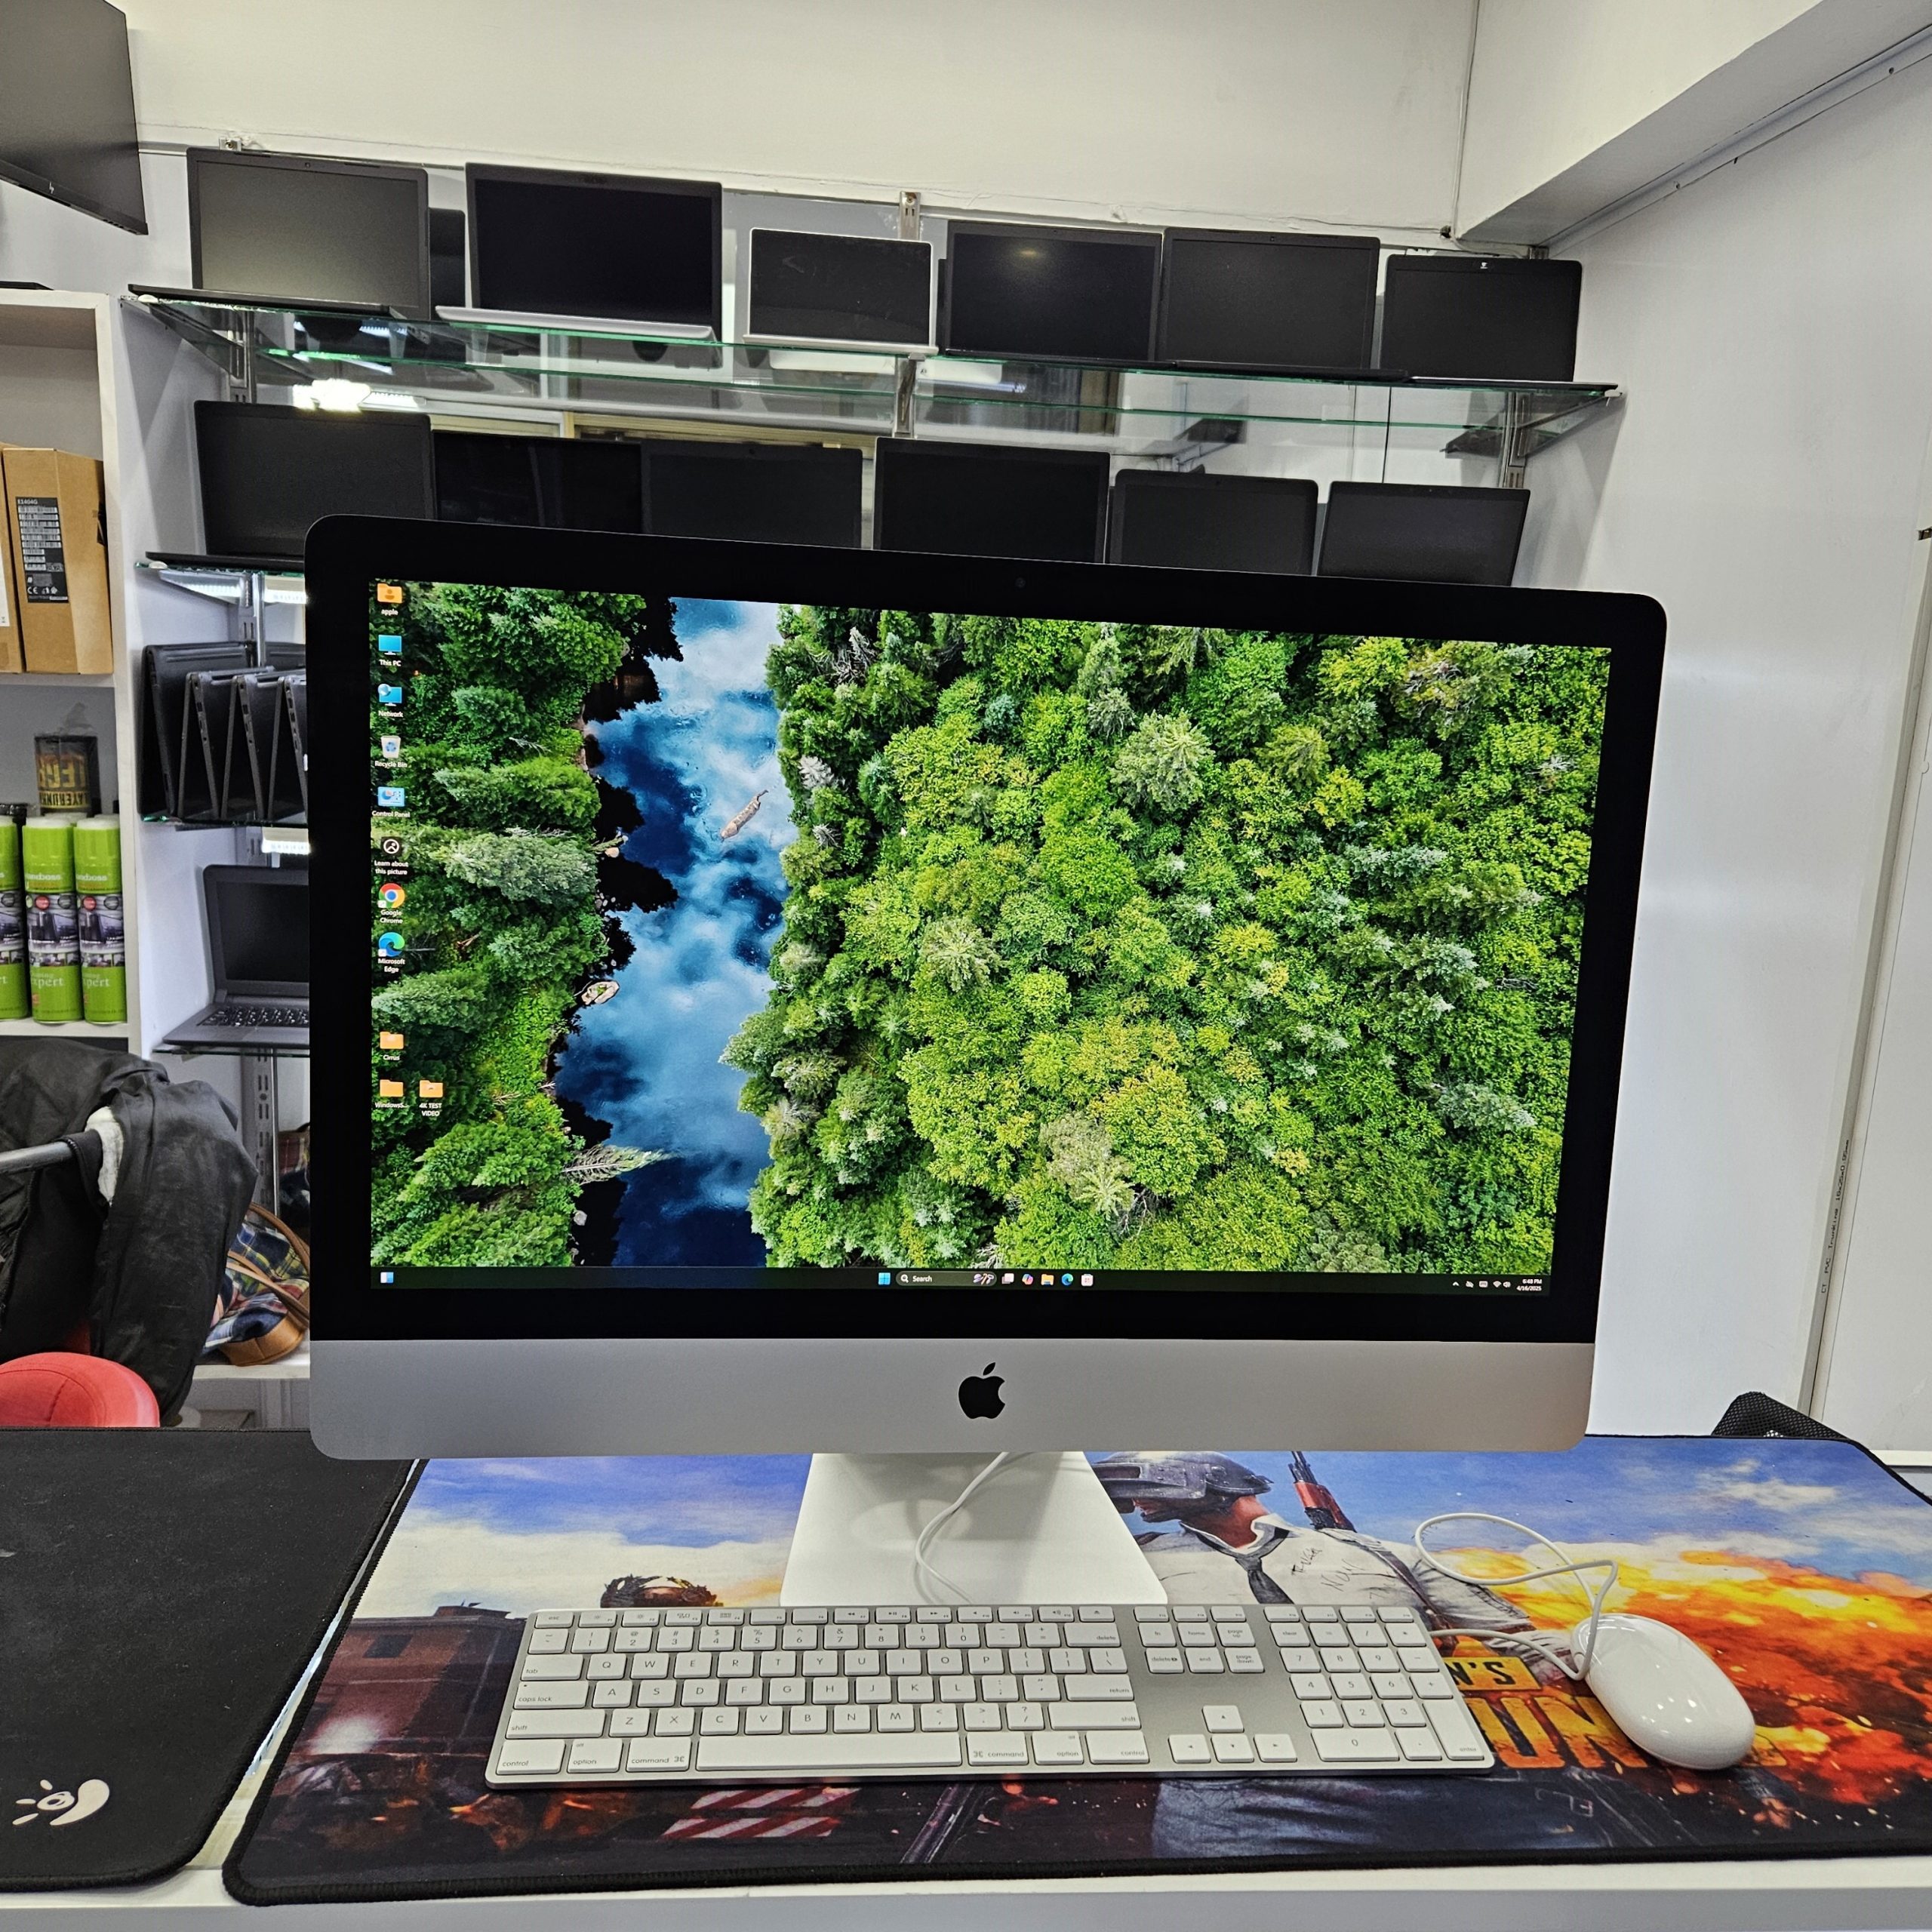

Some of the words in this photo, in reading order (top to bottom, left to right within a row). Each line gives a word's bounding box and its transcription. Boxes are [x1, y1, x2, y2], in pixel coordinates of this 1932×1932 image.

[32, 978, 63, 989] xpert
[776, 1658, 781, 1666] T
[817, 1657, 823, 1666] Y
[857, 1657, 866, 1666] U
[983, 1656, 990, 1664] P
[1297, 1654, 1303, 1663] 7
[732, 1659, 739, 1667] R
[654, 1687, 660, 1696] S
[696, 1687, 704, 1695] D
[741, 1686, 747, 1694] F
[783, 1685, 792, 1694] G
[826, 1684, 834, 1693] H
[1359, 1708, 1366, 1716] 2
[625, 1717, 634, 1725] Z
[669, 1715, 678, 1724] X
[715, 1715, 724, 1724] C
[759, 1715, 768, 1723] V
[804, 1714, 811, 1722] B
[1351, 1739, 1359, 1747] 0
